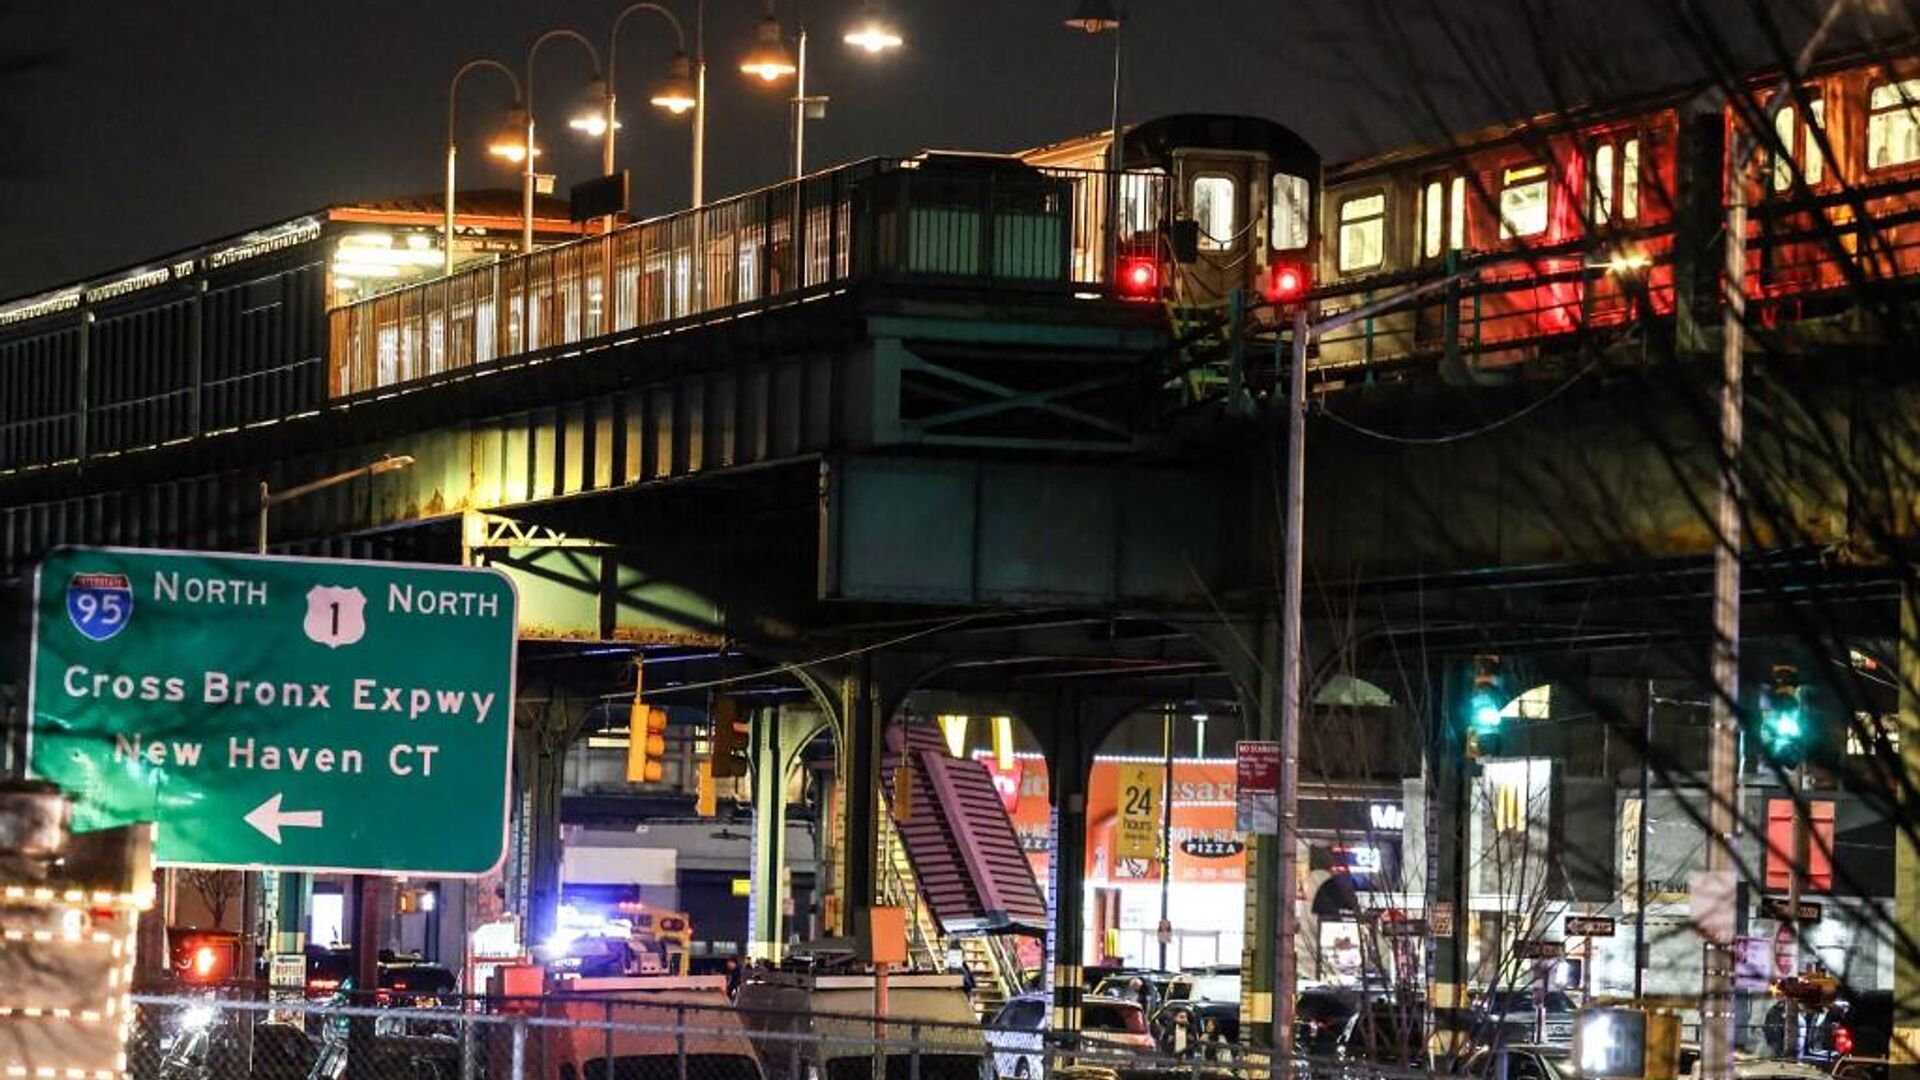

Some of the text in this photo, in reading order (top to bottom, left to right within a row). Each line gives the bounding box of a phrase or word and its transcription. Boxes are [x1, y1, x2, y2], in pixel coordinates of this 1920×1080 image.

[154, 571, 267, 605] NORTH
[388, 583, 498, 617] NORTH
[77, 594, 122, 625] 95
[330, 601, 339, 636] 1
[64, 666, 494, 724] Cross Bronx Expwy
[114, 732, 438, 777] New Haven CT
[1125, 785, 1152, 815] 24
[1123, 816, 1152, 831] hours
[1187, 842, 1236, 854] PIZZA
